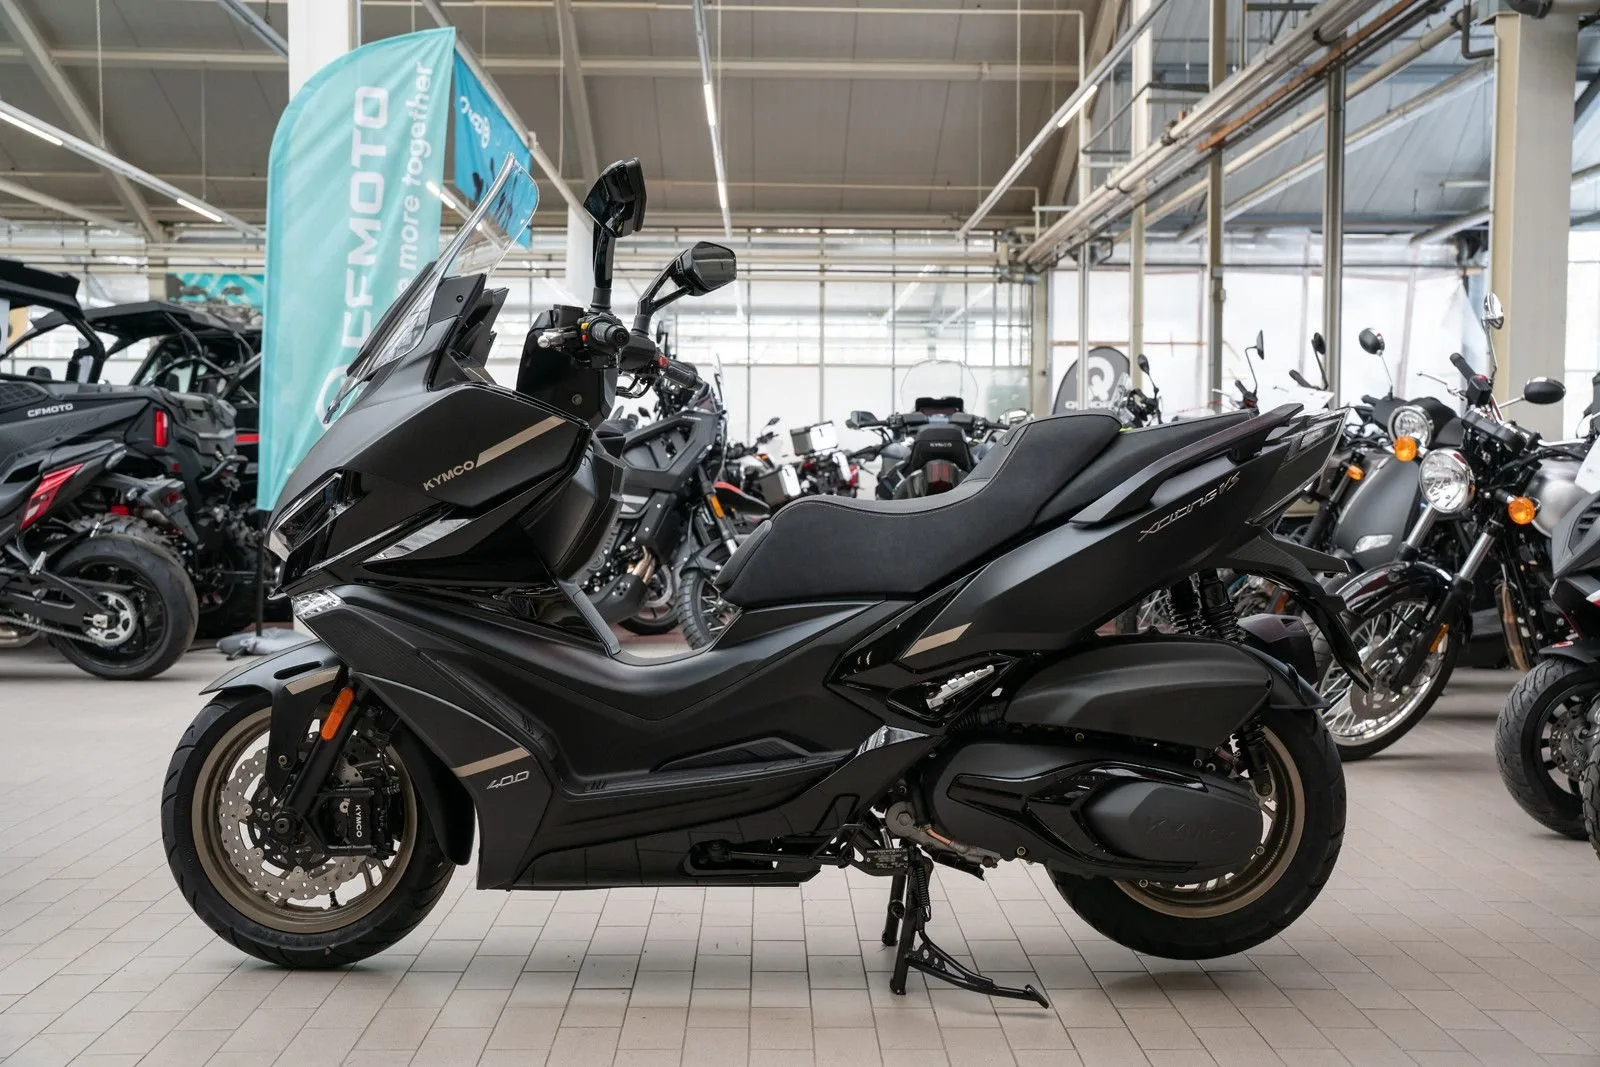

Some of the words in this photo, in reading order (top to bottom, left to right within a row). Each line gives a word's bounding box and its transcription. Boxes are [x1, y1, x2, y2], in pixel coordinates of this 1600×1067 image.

[402, 60, 433, 187] together
[341, 86, 389, 350] CFMOTO
[399, 194, 421, 270] more
[27, 403, 74, 418] CFMOTO
[423, 460, 475, 491] KYMCO
[486, 770, 530, 790] 400
[355, 804, 363, 838] KYMCO
